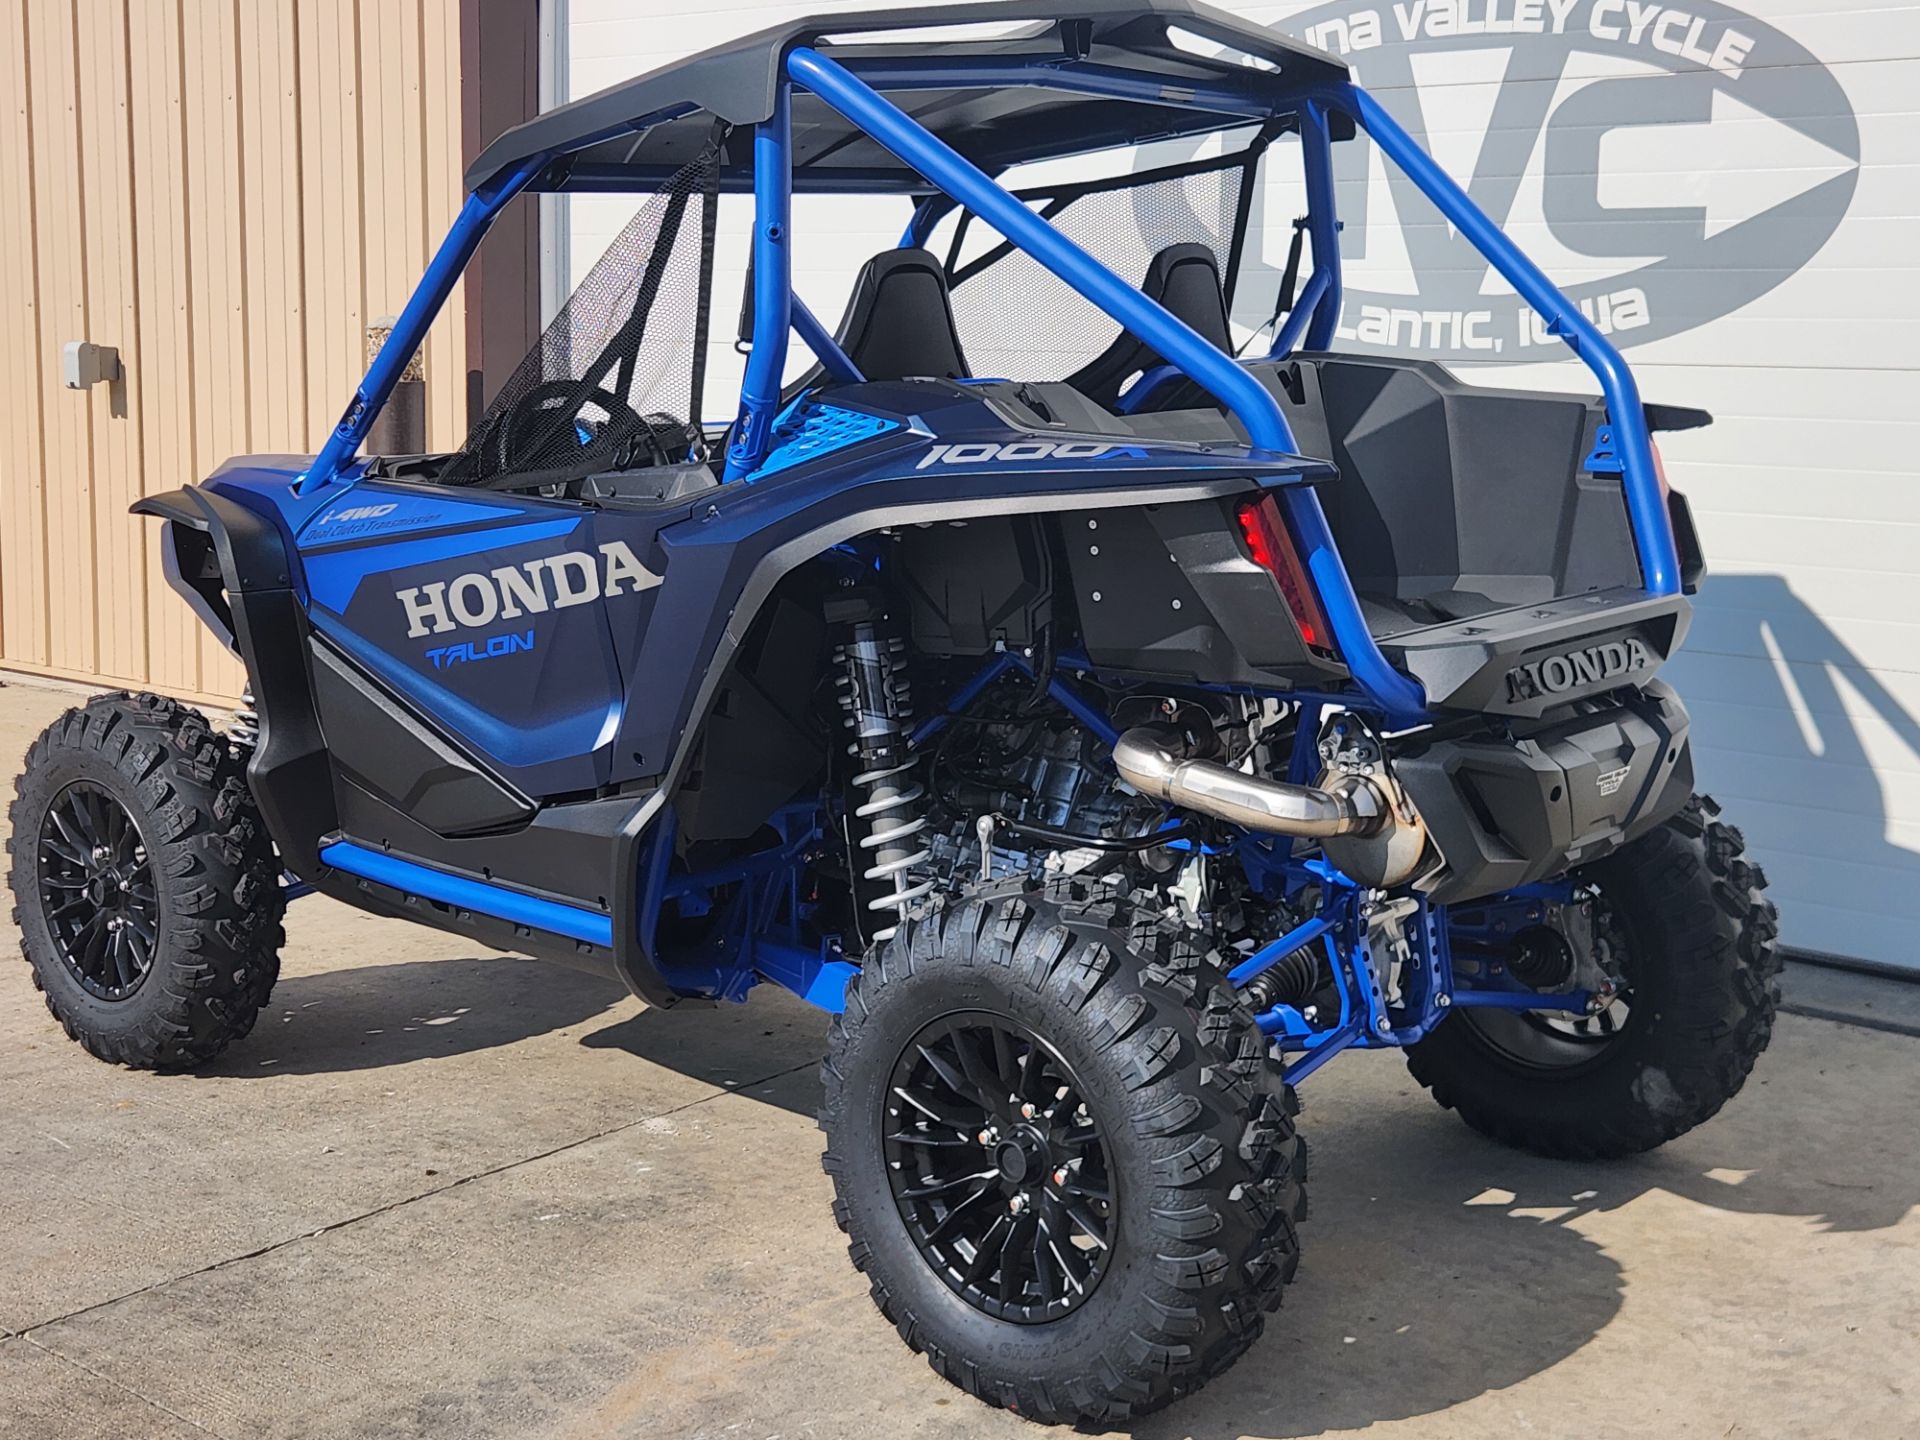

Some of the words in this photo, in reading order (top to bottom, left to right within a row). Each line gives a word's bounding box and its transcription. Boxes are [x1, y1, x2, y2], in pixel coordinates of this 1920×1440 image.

[1589, 1, 1755, 81] CYCLE
[365, 514, 442, 532] Transmission
[396, 540, 664, 638] HONDA
[425, 629, 534, 670] TALON
[1506, 637, 1649, 704] HONDA
